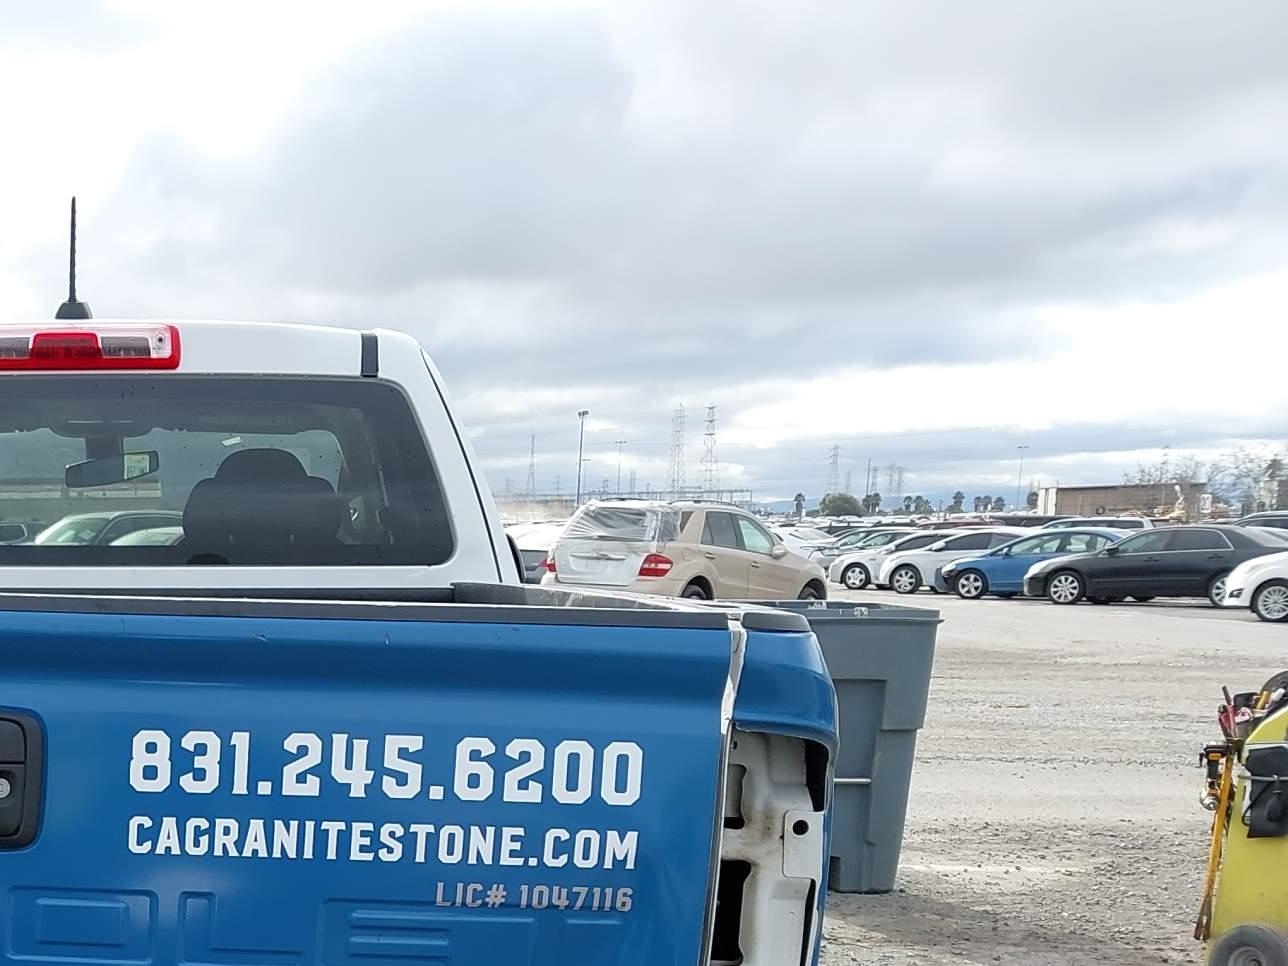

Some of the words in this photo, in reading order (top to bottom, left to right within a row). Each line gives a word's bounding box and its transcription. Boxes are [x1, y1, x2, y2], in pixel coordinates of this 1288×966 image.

[129, 729, 643, 806] 831.245.6200
[128, 815, 639, 870] CAGRANITESTONE.COM
[435, 881, 508, 908] LIC#
[519, 884, 634, 912] 1047116
